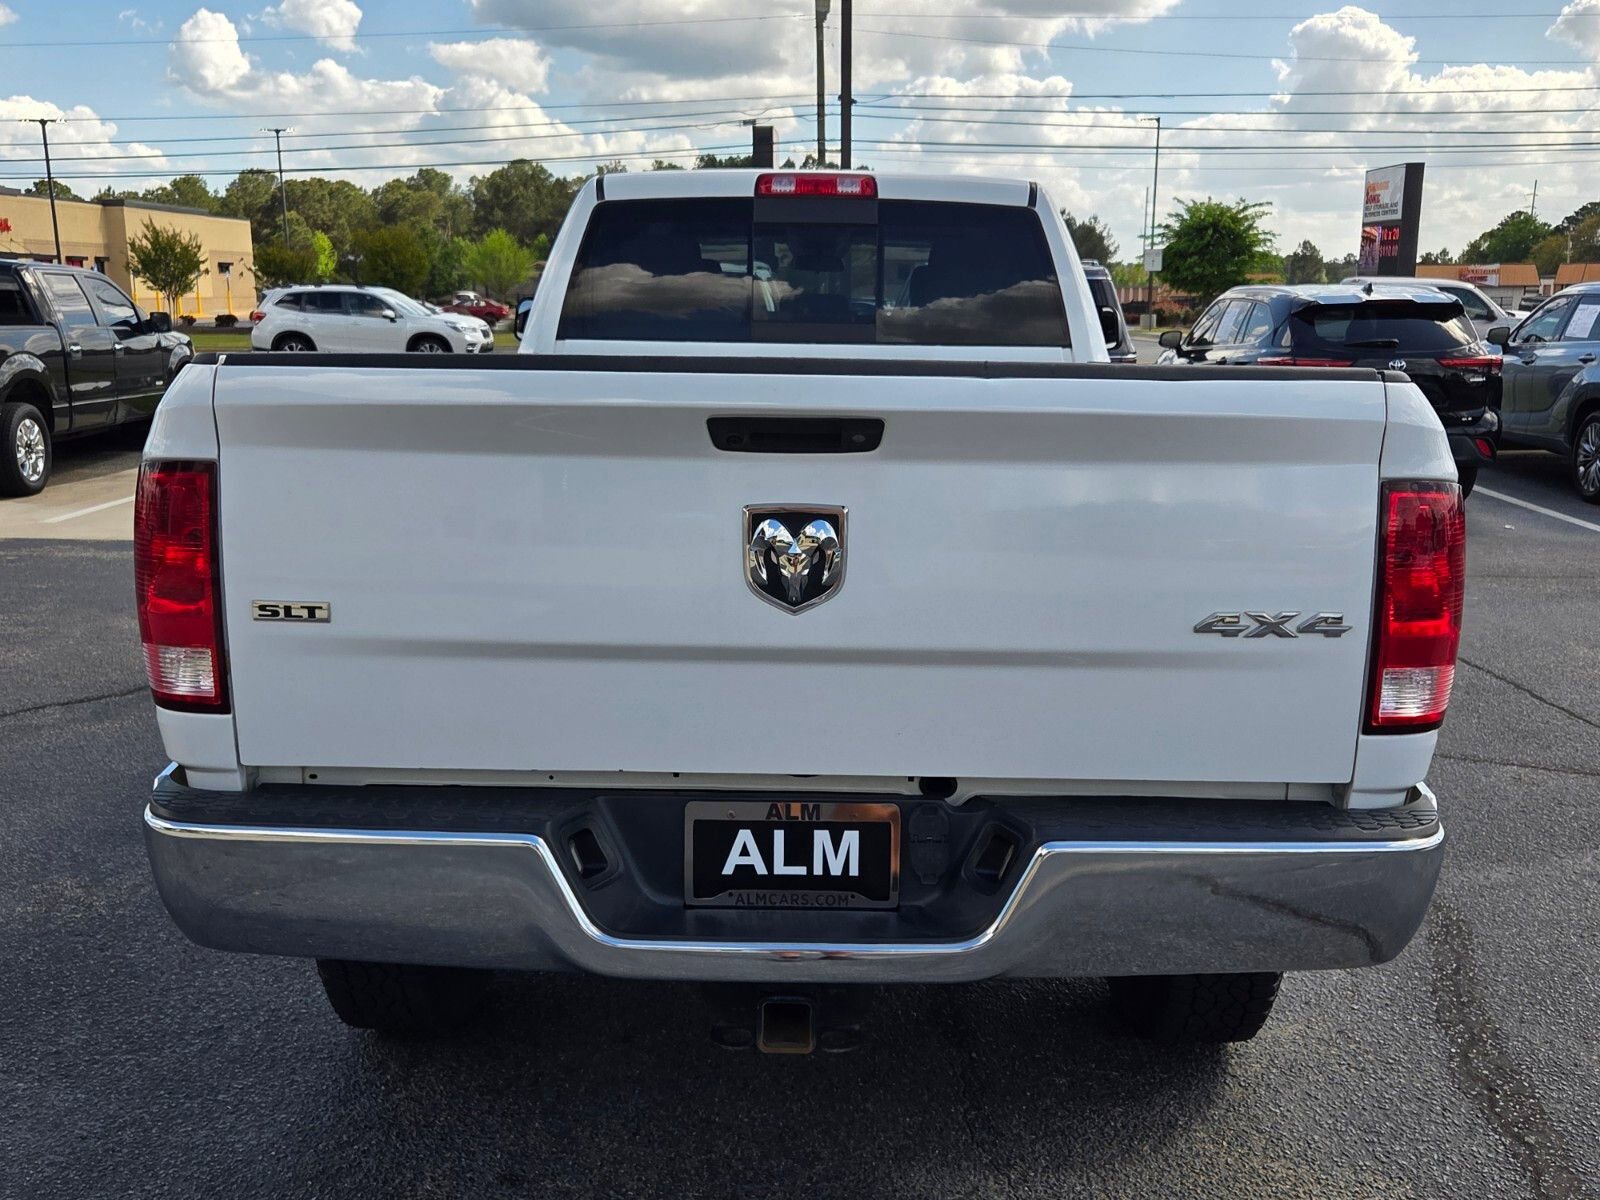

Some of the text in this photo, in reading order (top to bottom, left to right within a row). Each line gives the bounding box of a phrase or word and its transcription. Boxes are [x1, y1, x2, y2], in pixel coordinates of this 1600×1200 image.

[257, 604, 323, 619] SLT
[1193, 610, 1353, 638] 4X4
[765, 802, 821, 821] ALM
[721, 828, 860, 877] ALM
[734, 892, 849, 907] ALMCARS.COM
